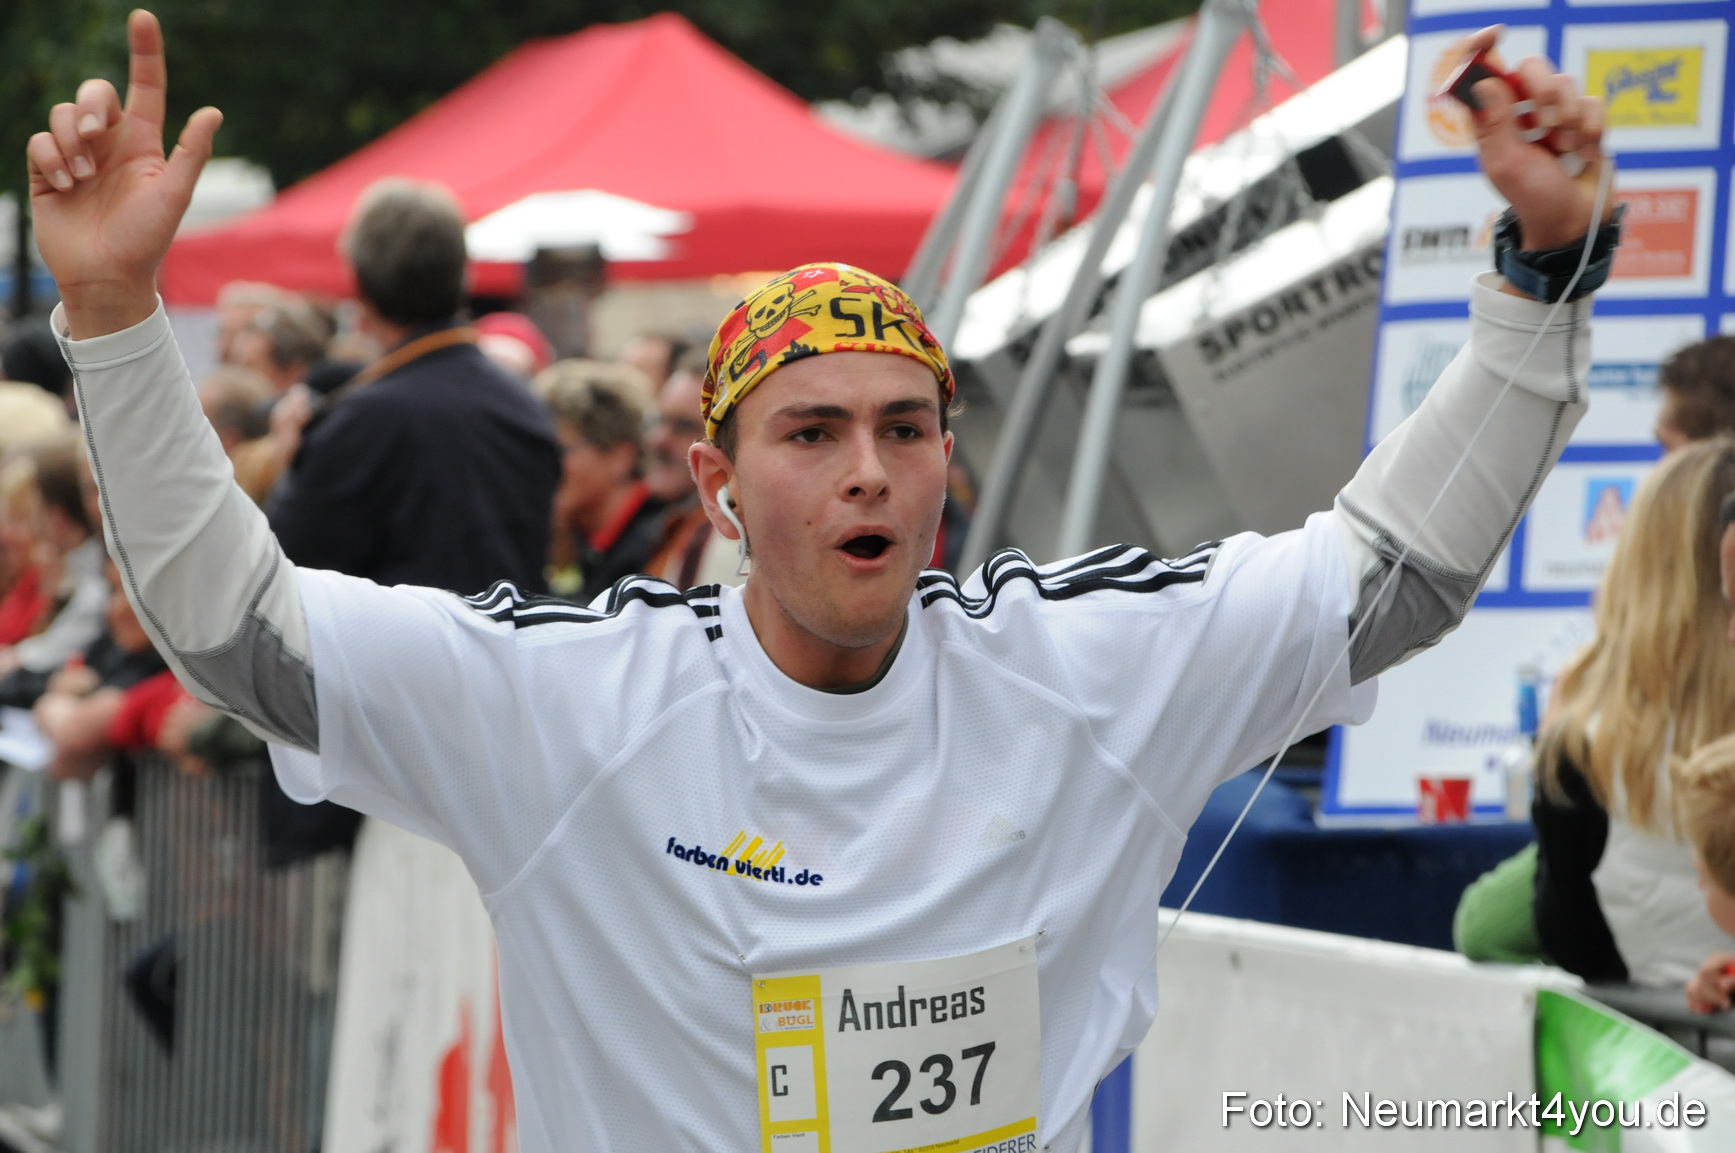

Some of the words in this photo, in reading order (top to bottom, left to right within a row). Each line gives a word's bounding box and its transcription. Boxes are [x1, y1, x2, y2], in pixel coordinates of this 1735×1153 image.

[666, 836, 729, 872] farben
[735, 857, 823, 887] viertl.de
[838, 984, 987, 1033] Andreas
[771, 1064, 789, 1097] C
[871, 1041, 996, 1123] 237
